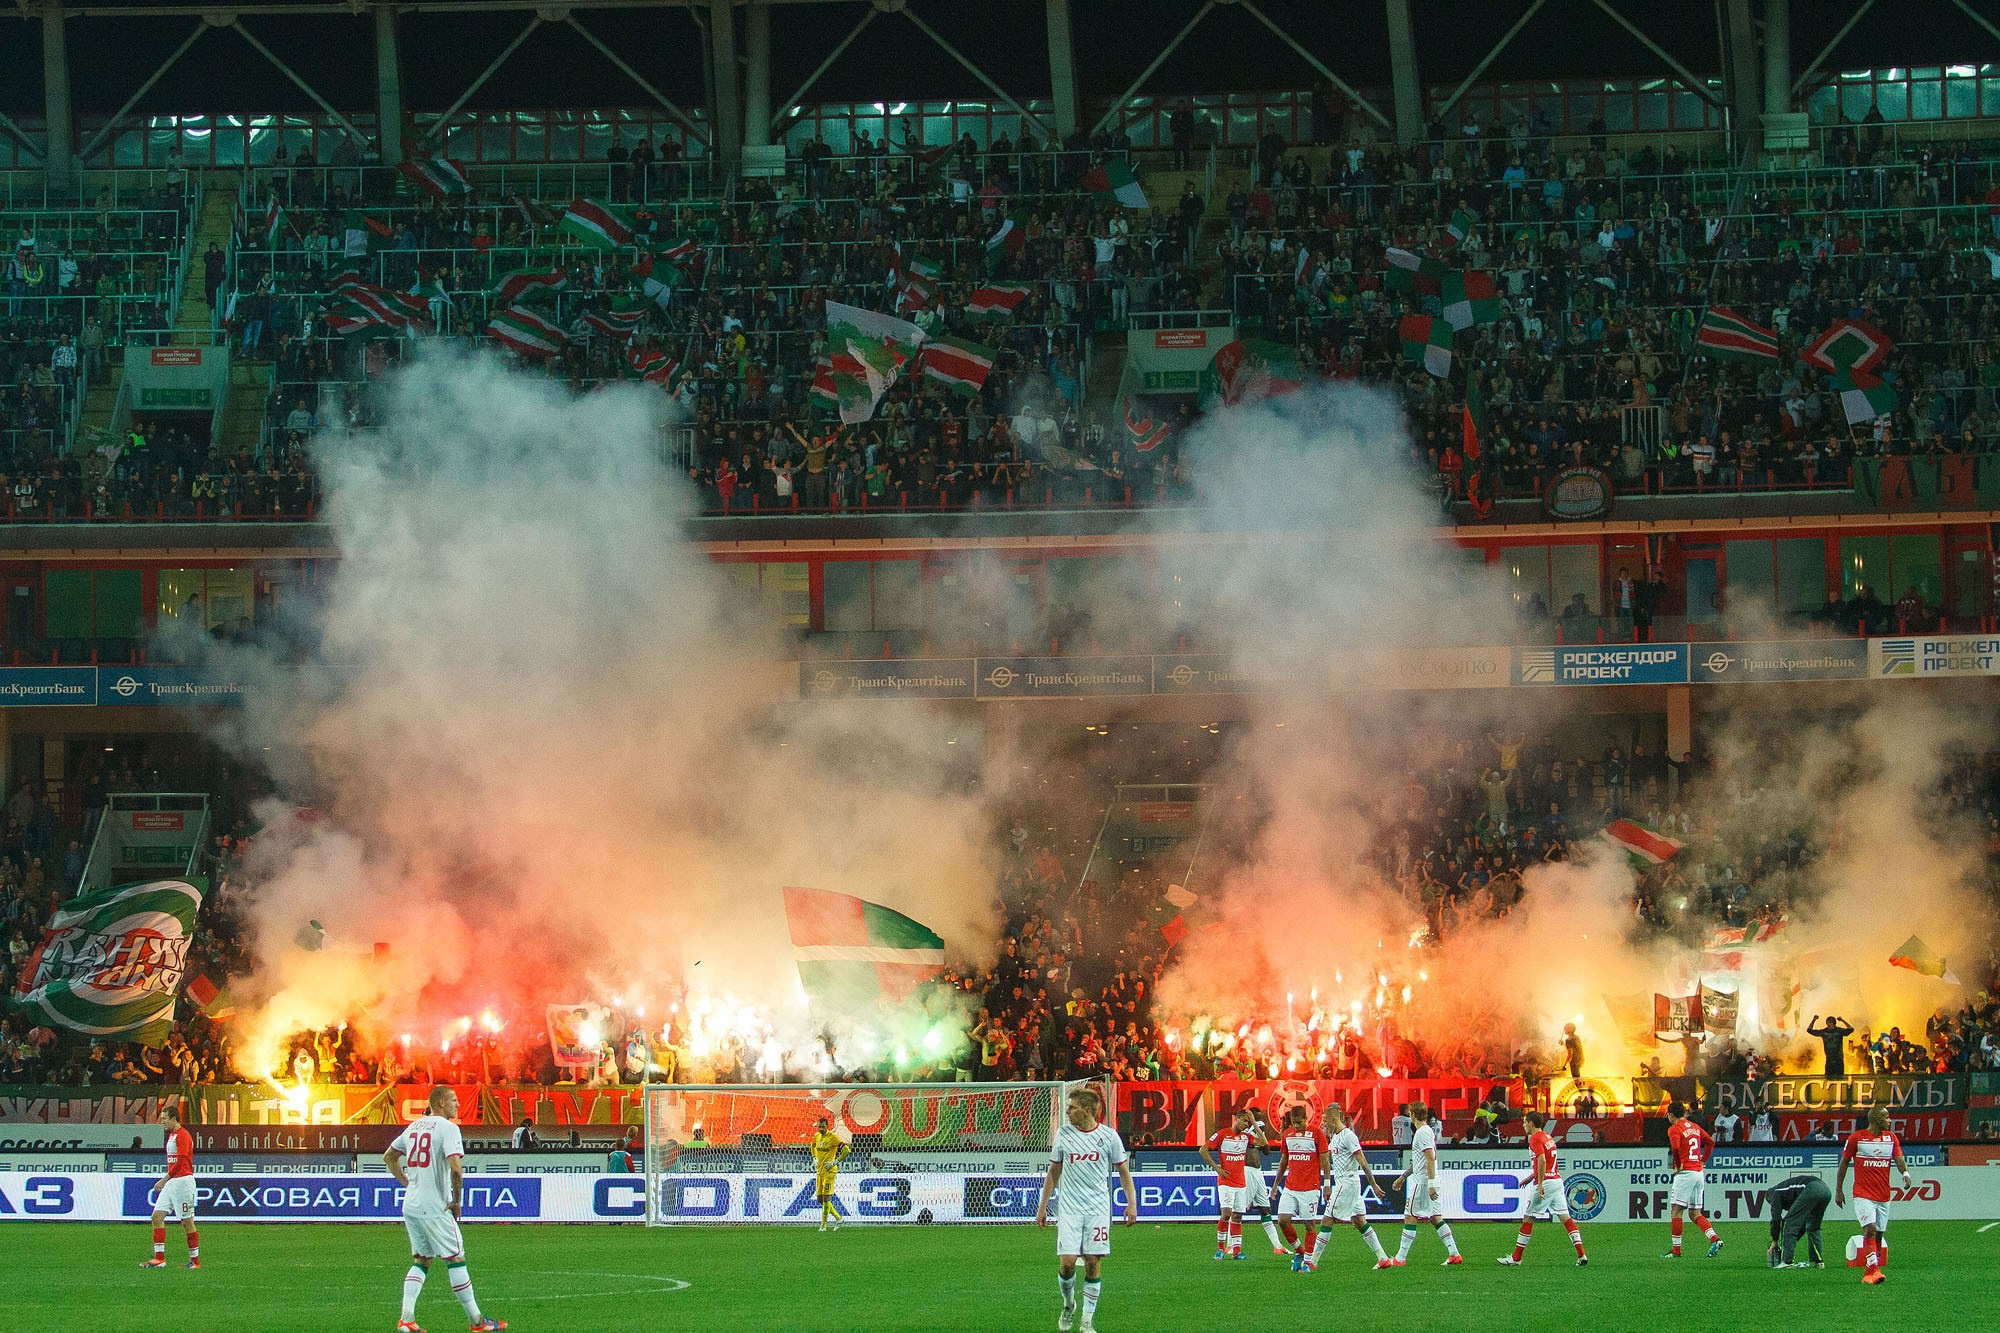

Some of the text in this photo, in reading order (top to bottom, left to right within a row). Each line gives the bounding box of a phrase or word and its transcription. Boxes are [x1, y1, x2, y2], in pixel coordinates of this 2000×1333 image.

[1924, 640, 2000, 655] РОСЖЕЛ
[1563, 651, 1677, 665] РОСЖЕЛДОР
[1742, 657, 1857, 669] ТрансКредитБанк
[1924, 656, 1992, 671] ПРОЕКТ
[1025, 673, 1145, 686] ТрансКредитБанк
[1563, 666, 1633, 679] ПРОЕКТ
[848, 676, 967, 689] ТрансКредитБанк
[1714, 1078, 1957, 1110] ВМЕСТЕ МЫ
[196, 1131, 214, 1149] he
[319, 1131, 359, 1149] knot
[408, 1132, 432, 1168] 28
[1688, 1137, 1699, 1160] 2
[1442, 1160, 1531, 1170] РОСЖЕЛДОР
[1573, 1159, 1662, 1170] РОСЖЕЛДОР
[1713, 1157, 1803, 1168] РОСЖЕЛДОР
[1630, 1173, 1651, 1185] ВСЕ
[1705, 1173, 1718, 1184] СЕ
[1721, 1172, 1767, 1184] МАТЧИ!
[374, 1187, 517, 1208] ГРПА
[1093, 1226, 1109, 1242] 26
